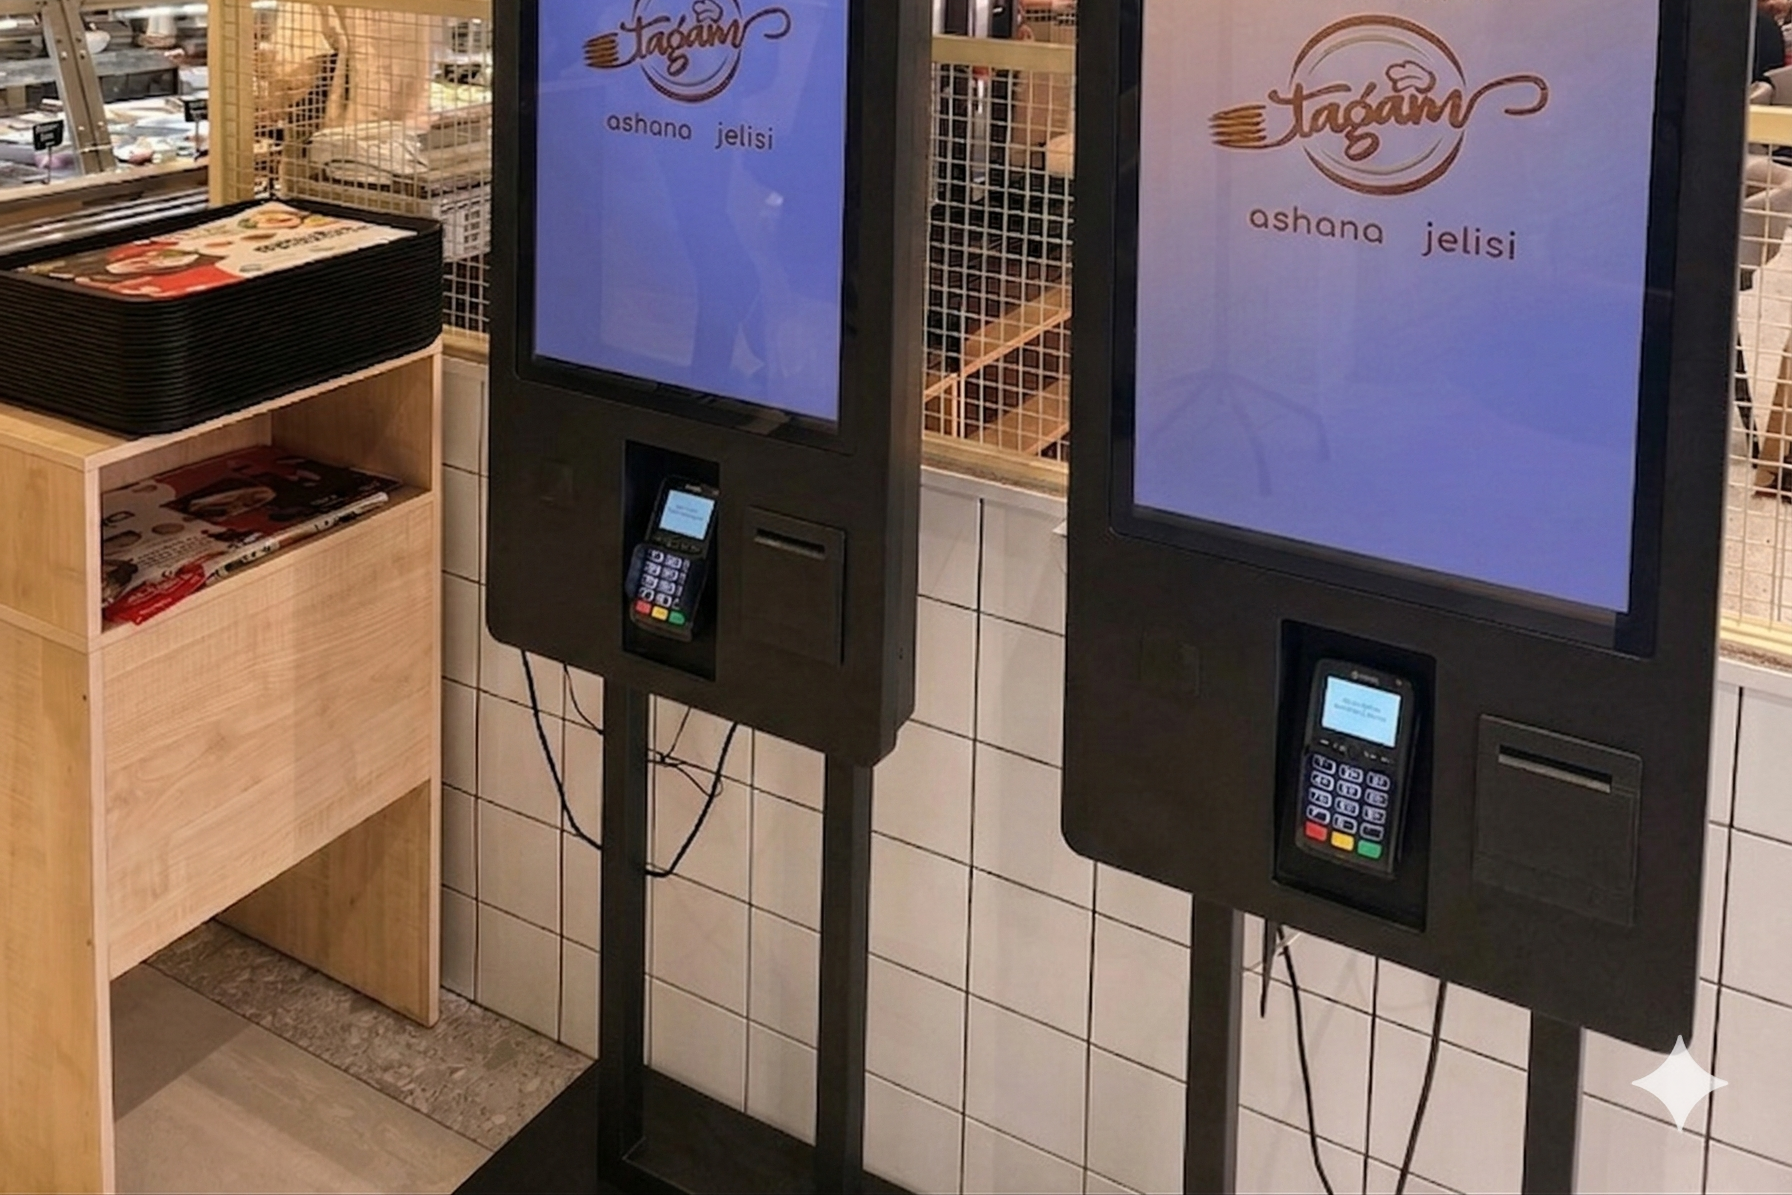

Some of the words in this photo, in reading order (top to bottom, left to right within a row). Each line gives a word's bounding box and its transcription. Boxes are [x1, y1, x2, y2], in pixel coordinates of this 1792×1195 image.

[606, 112, 692, 141] ashana
[714, 121, 774, 150] jelisi
[1249, 205, 1384, 245] ashana
[1420, 220, 1517, 261] jelisi
